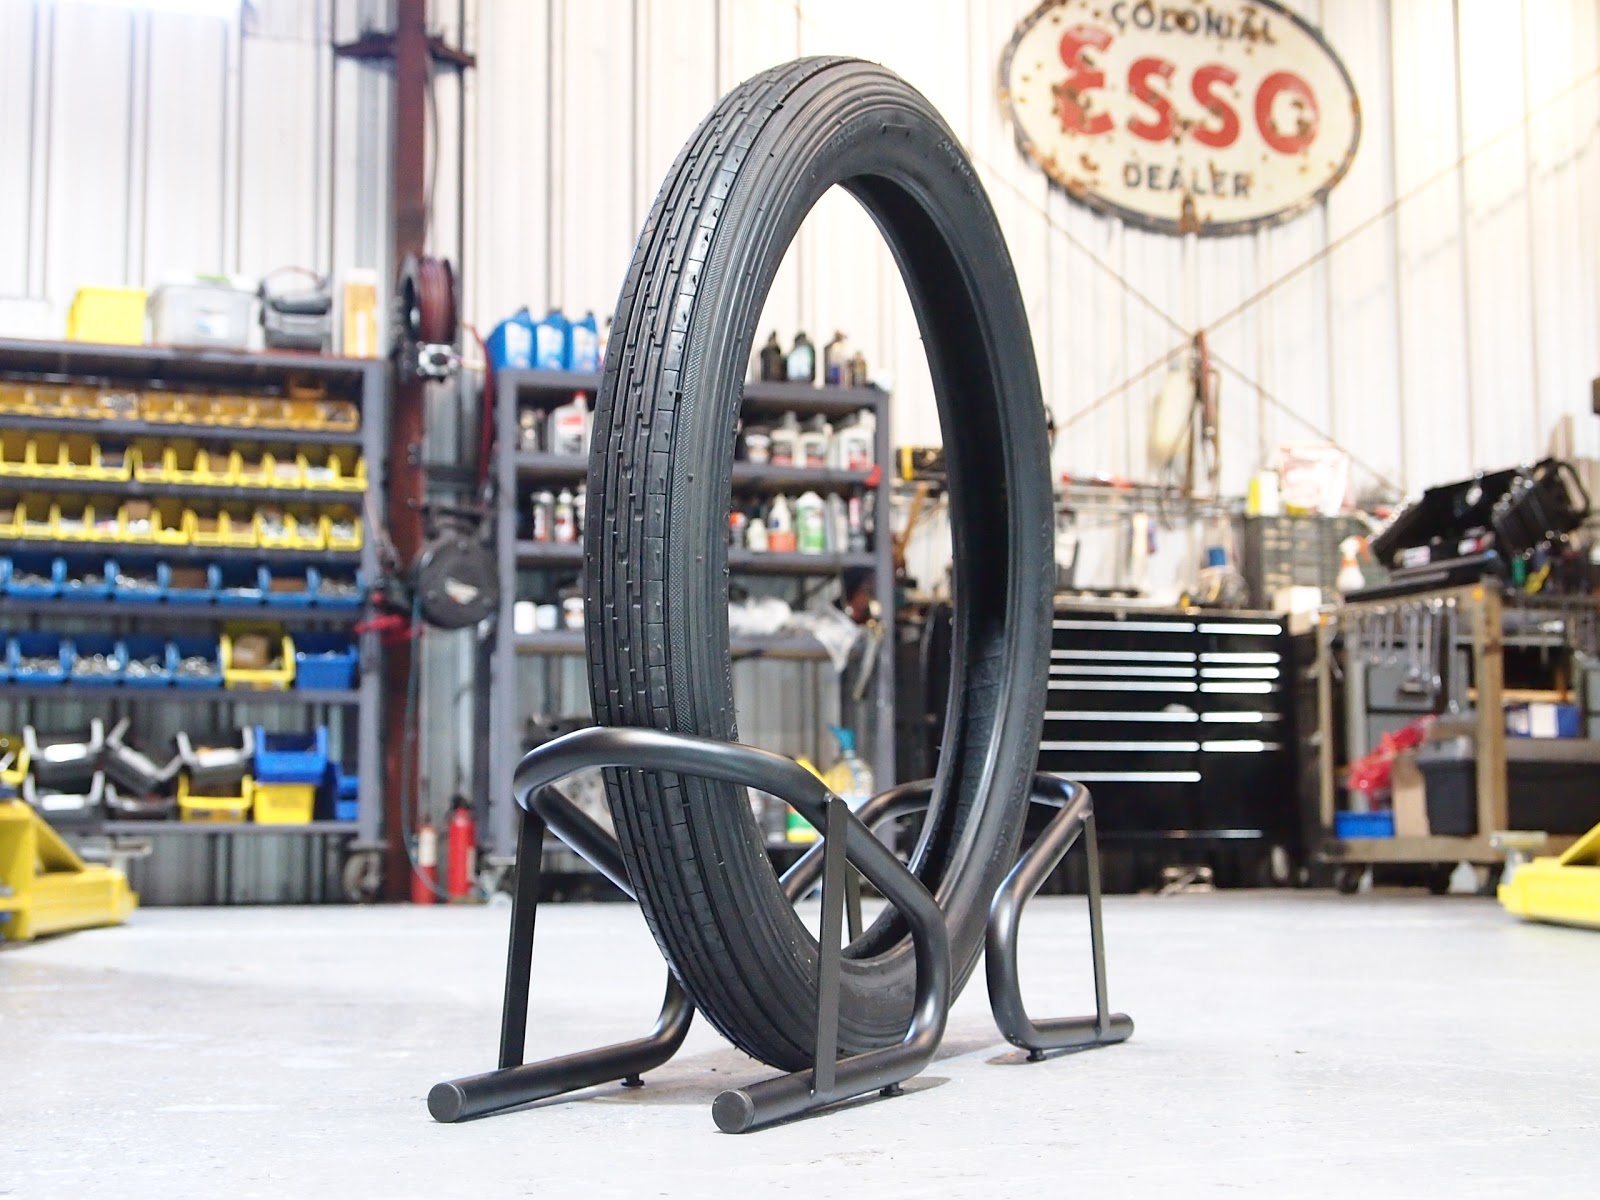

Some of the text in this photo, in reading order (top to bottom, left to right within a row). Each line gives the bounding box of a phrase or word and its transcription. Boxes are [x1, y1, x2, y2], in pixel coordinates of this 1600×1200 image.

[1111, 2, 1276, 44] COLONIAL
[1059, 26, 1320, 155] ESSO
[1124, 164, 1250, 197] DEALER
